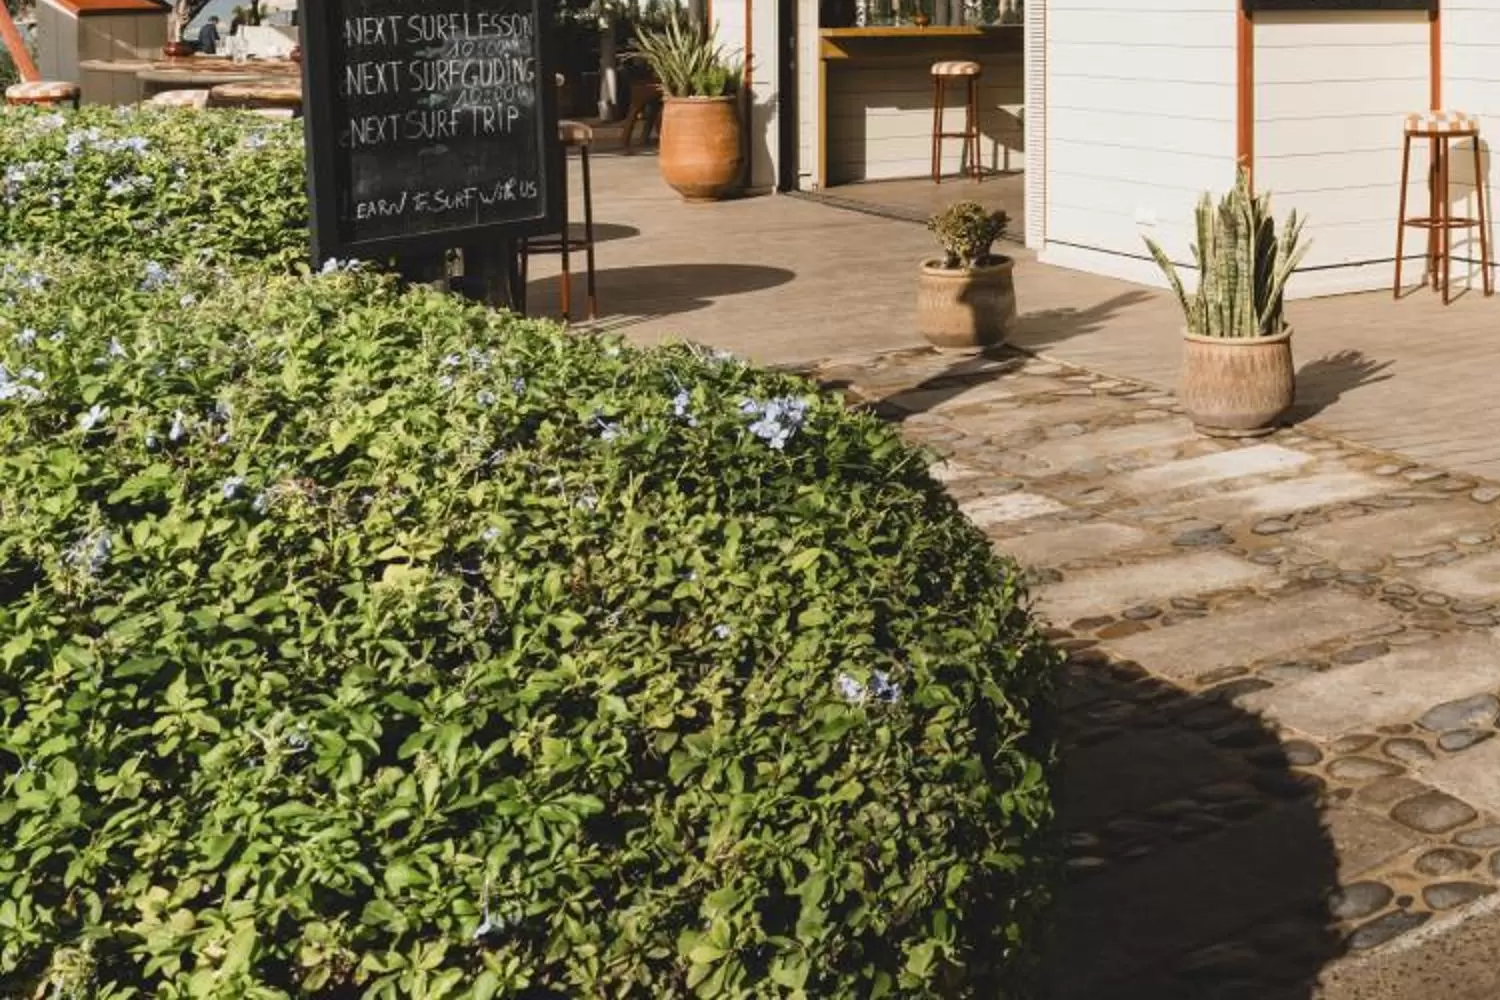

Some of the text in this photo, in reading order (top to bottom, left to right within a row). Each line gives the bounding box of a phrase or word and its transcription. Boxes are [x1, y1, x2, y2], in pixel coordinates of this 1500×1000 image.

[345, 12, 534, 46] NEXT SURF LESSON
[345, 60, 403, 96] NEXT
[350, 114, 401, 149] NEXT
[404, 109, 462, 139] SURF
